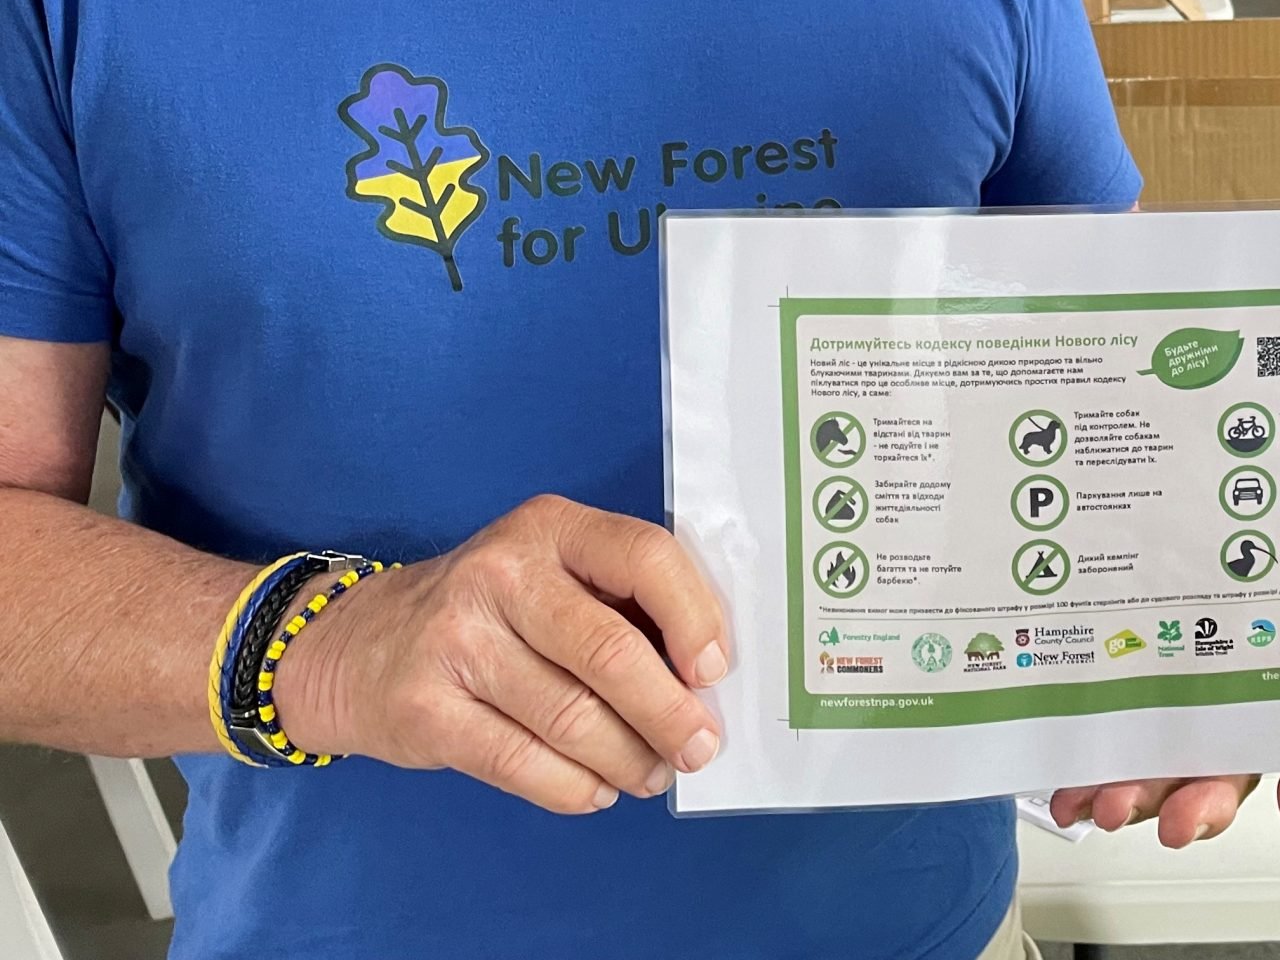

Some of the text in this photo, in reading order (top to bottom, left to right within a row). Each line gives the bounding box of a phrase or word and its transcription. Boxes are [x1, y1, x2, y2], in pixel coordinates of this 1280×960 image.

[497, 128, 838, 200] New Forest
[497, 216, 586, 267] for
[810, 334, 1138, 352] Дотримуйтесь кодексу поведінки Нового лісу
[1164, 341, 1198, 357] Будьте
[1168, 344, 1219, 368] дружніми
[810, 359, 836, 367] Новий
[869, 360, 910, 368] унікальне
[944, 359, 986, 367] рідкісною
[1018, 358, 1062, 366] природою
[1075, 356, 1103, 364] вільно
[1171, 358, 1210, 377] до лісу!
[810, 369, 862, 378] блукаючими
[913, 369, 950, 378] Дякуємо
[811, 380, 858, 388] піклуватися
[890, 379, 929, 387] особливе
[932, 379, 958, 387] місце,
[960, 379, 1022, 387] дотримуючись
[1025, 378, 1057, 386] простих
[1060, 377, 1091, 385] правил
[1093, 376, 1126, 384] кодексу
[1074, 409, 1140, 420] Тримайте собак
[873, 418, 920, 426] Тримайтеся
[1075, 423, 1087, 431] під
[873, 430, 950, 439] відстані від тварин
[1074, 434, 1122, 444] дозволяйте
[891, 442, 922, 451] годуйте
[1075, 446, 1129, 454] наближатися
[874, 454, 919, 462] торкайтеся
[1086, 457, 1146, 467] переслідувати
[875, 480, 917, 489] Забирайте
[913, 492, 945, 501] відходи
[1076, 491, 1125, 500] Паркування
[1128, 490, 1150, 498] лише
[1030, 488, 1054, 518] P
[1076, 503, 1131, 511] автостоянках
[889, 554, 931, 562] розводьте
[1077, 552, 1139, 563] Дикий кемпінг
[931, 565, 962, 574] готуйте
[1078, 563, 1134, 574] заборонений
[1034, 625, 1094, 638] Hampshire
[843, 633, 900, 642] Forestry England
[1034, 636, 1094, 646] County Council
[1109, 639, 1126, 654] go
[837, 657, 883, 665] NEW FOREST
[1033, 651, 1095, 661] New Forest
[837, 665, 883, 674] COMMONERS
[820, 696, 934, 709] newforestnpa.gov.uk
